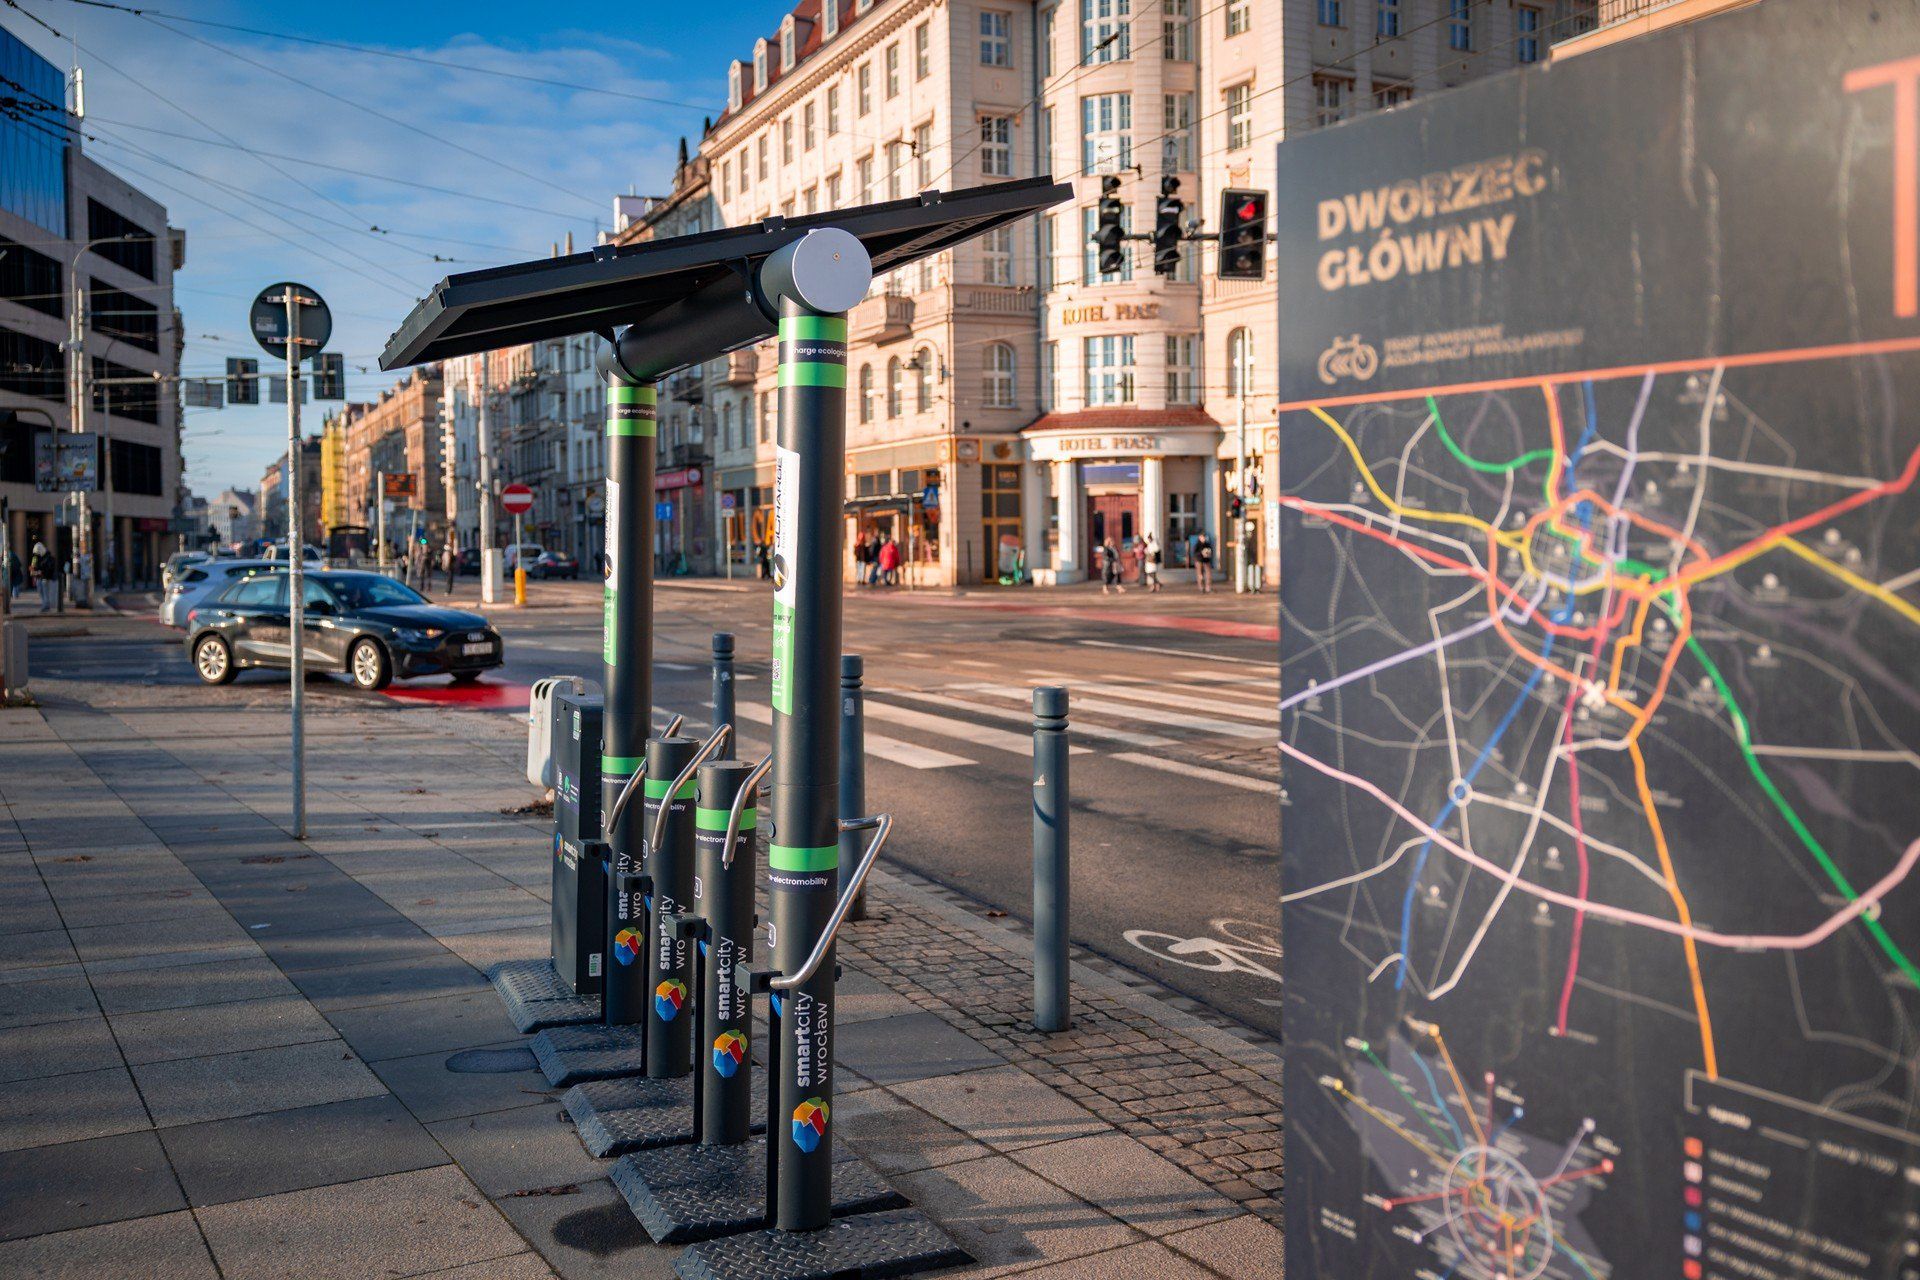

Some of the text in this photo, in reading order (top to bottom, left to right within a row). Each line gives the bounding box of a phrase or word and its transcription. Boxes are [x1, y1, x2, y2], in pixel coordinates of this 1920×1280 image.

[1317, 151, 1548, 240] DWORZEC
[1317, 213, 1516, 292] GŁÓWNY
[1063, 306, 1110, 326] HOTEL
[617, 852, 631, 920] smaity
[632, 861, 642, 919] wrow
[675, 904, 687, 969] wrow
[717, 936, 734, 1020] smartcity
[736, 946, 747, 1019] wrow
[794, 991, 813, 1087] smartcity
[814, 1002, 828, 1084] wrocław
